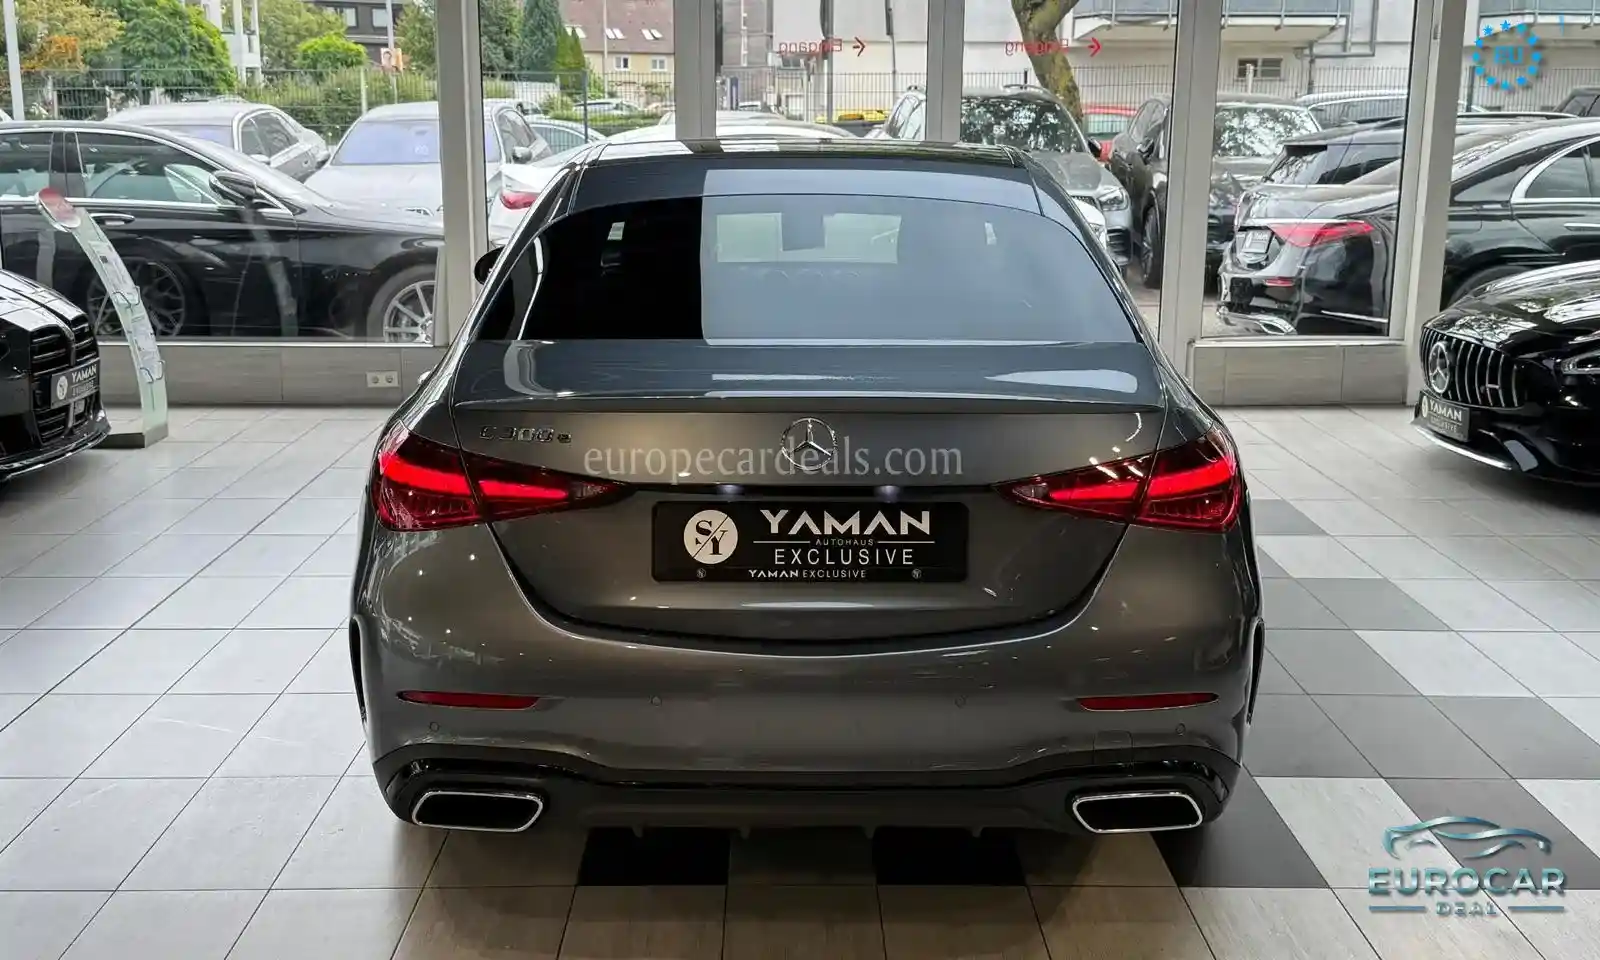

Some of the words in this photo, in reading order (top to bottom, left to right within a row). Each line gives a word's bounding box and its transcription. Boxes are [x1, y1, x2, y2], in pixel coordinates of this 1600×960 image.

[72, 364, 97, 383] YAMAN
[1429, 399, 1462, 422] YAMAN
[759, 509, 931, 536] YAMAN
[815, 538, 874, 546] AUTOHAUS
[774, 548, 914, 565] EXCLUSIVE
[748, 569, 799, 578] YAMAN
[802, 569, 866, 578] EXCLUSIVE
